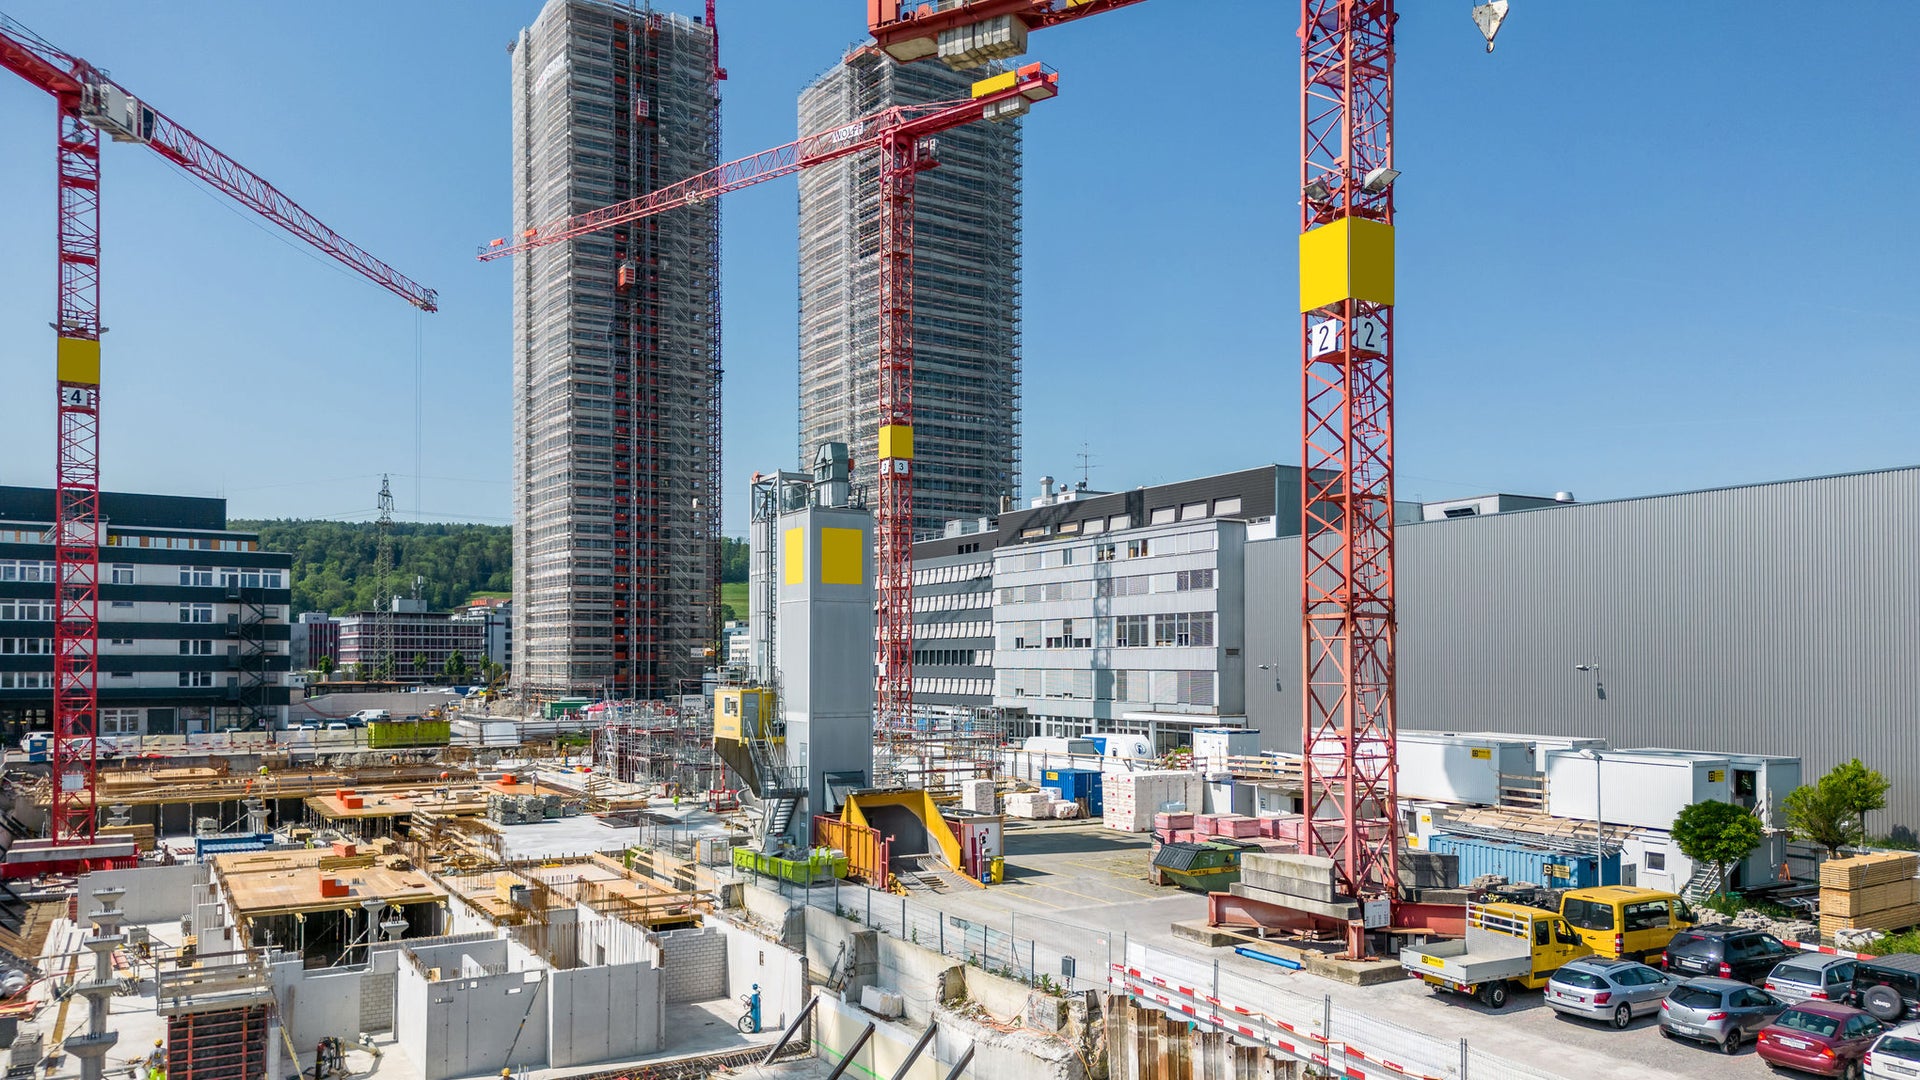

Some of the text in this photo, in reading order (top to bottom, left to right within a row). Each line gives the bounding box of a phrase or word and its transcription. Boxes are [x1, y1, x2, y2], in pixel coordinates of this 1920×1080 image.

[1319, 325, 1329, 353] 2
[1364, 321, 1375, 348] 2
[71, 389, 82, 404] 4
[898, 462, 904, 471] 3
[1873, 999, 1890, 1008] Jeep
